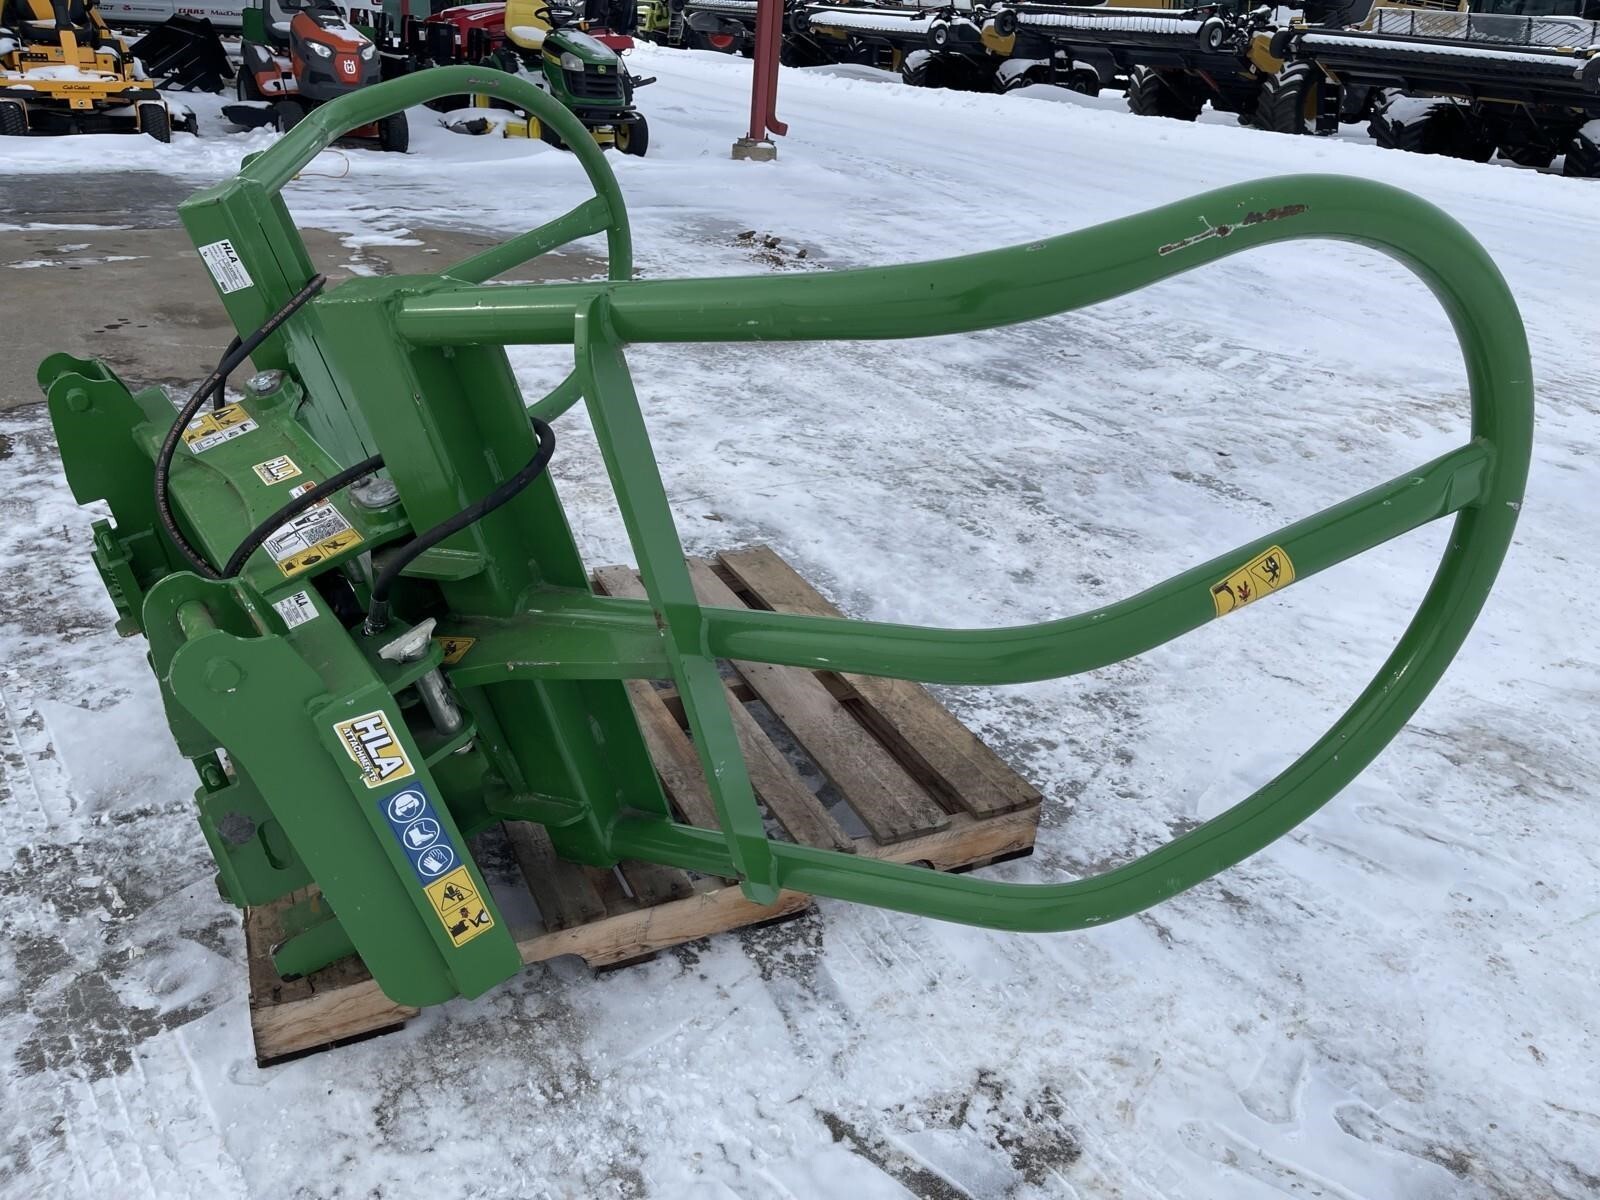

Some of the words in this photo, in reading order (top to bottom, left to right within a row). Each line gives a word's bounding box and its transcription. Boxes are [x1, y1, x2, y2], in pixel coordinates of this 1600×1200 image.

[221, 242, 238, 263] HLA
[263, 456, 295, 481] HLA
[292, 592, 309, 607] HLA
[351, 714, 405, 780] HLA
